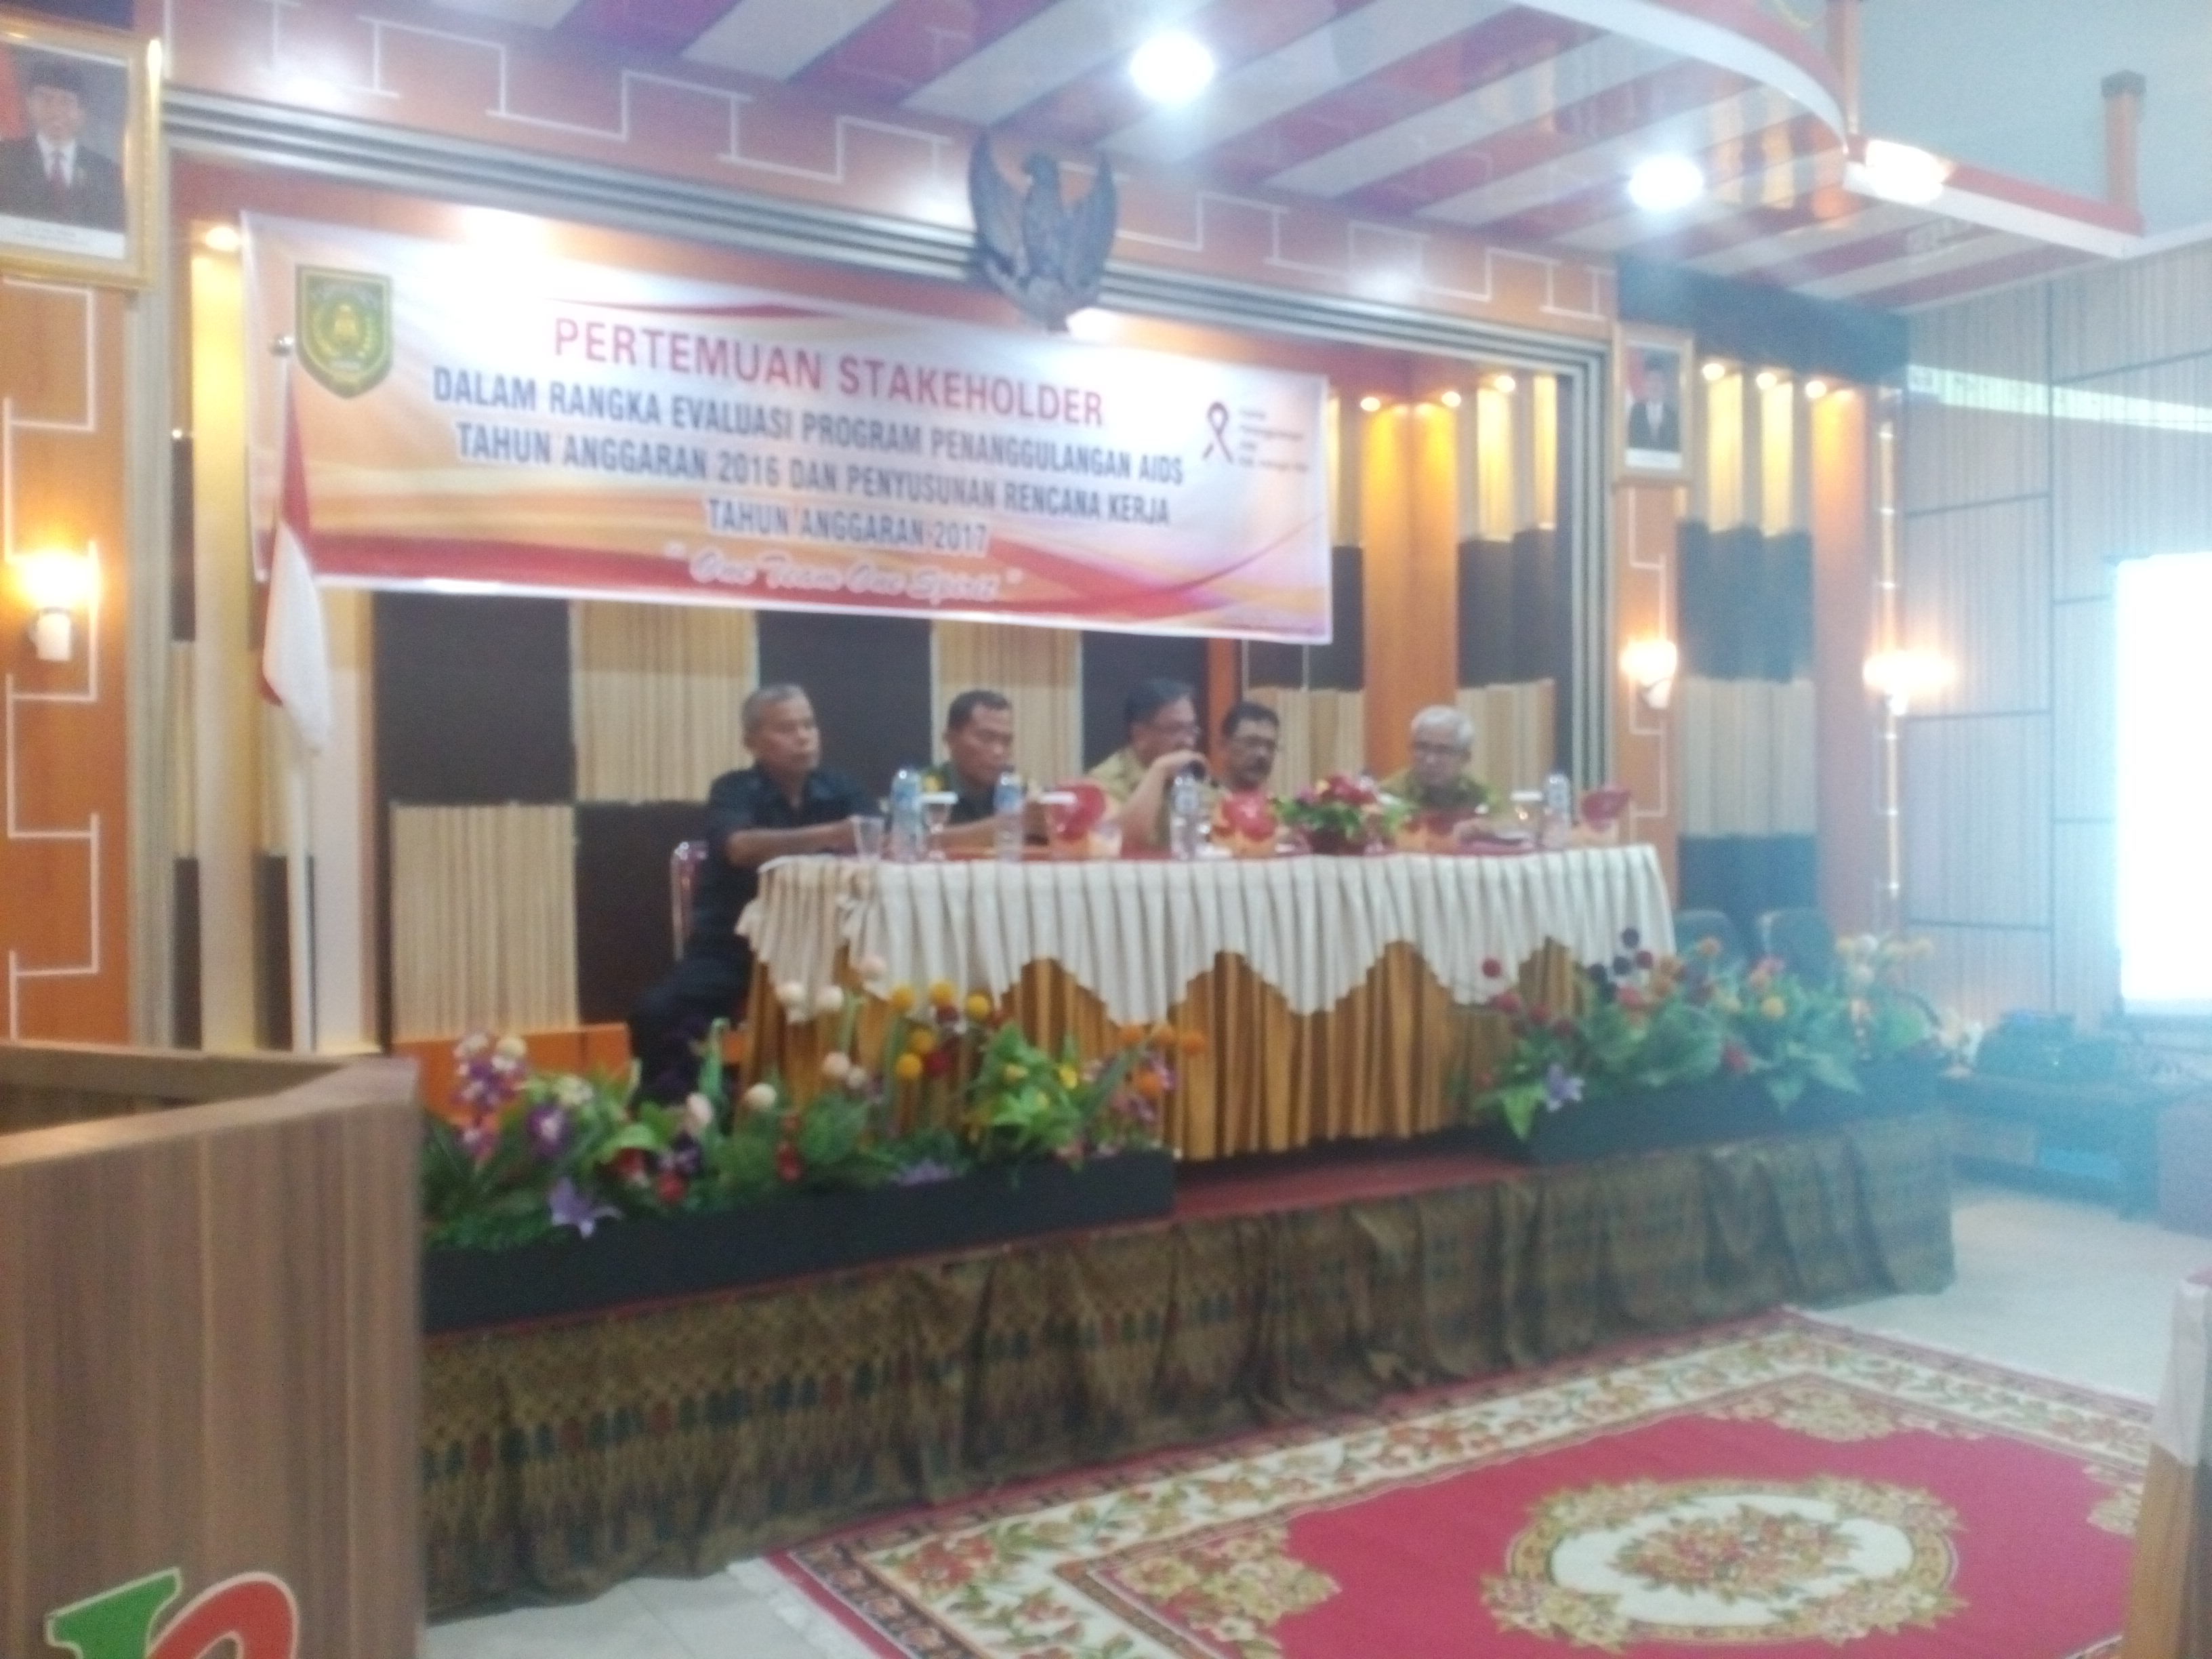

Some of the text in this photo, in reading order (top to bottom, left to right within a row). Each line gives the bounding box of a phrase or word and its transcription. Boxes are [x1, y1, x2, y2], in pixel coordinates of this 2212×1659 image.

[554, 317, 1103, 424] PERTEMUAN STAKEHOLDER
[433, 366, 1184, 485] DALAM RANGKA EVALUASI PROGRAM PENANGGULANGAN AIDS
[457, 422, 1170, 526] TAHUN ANGGARAN 2016 DAN PENYUSUNAN RENCANA KERJA
[709, 497, 987, 552] TAHUN ANGGARAN 2017
